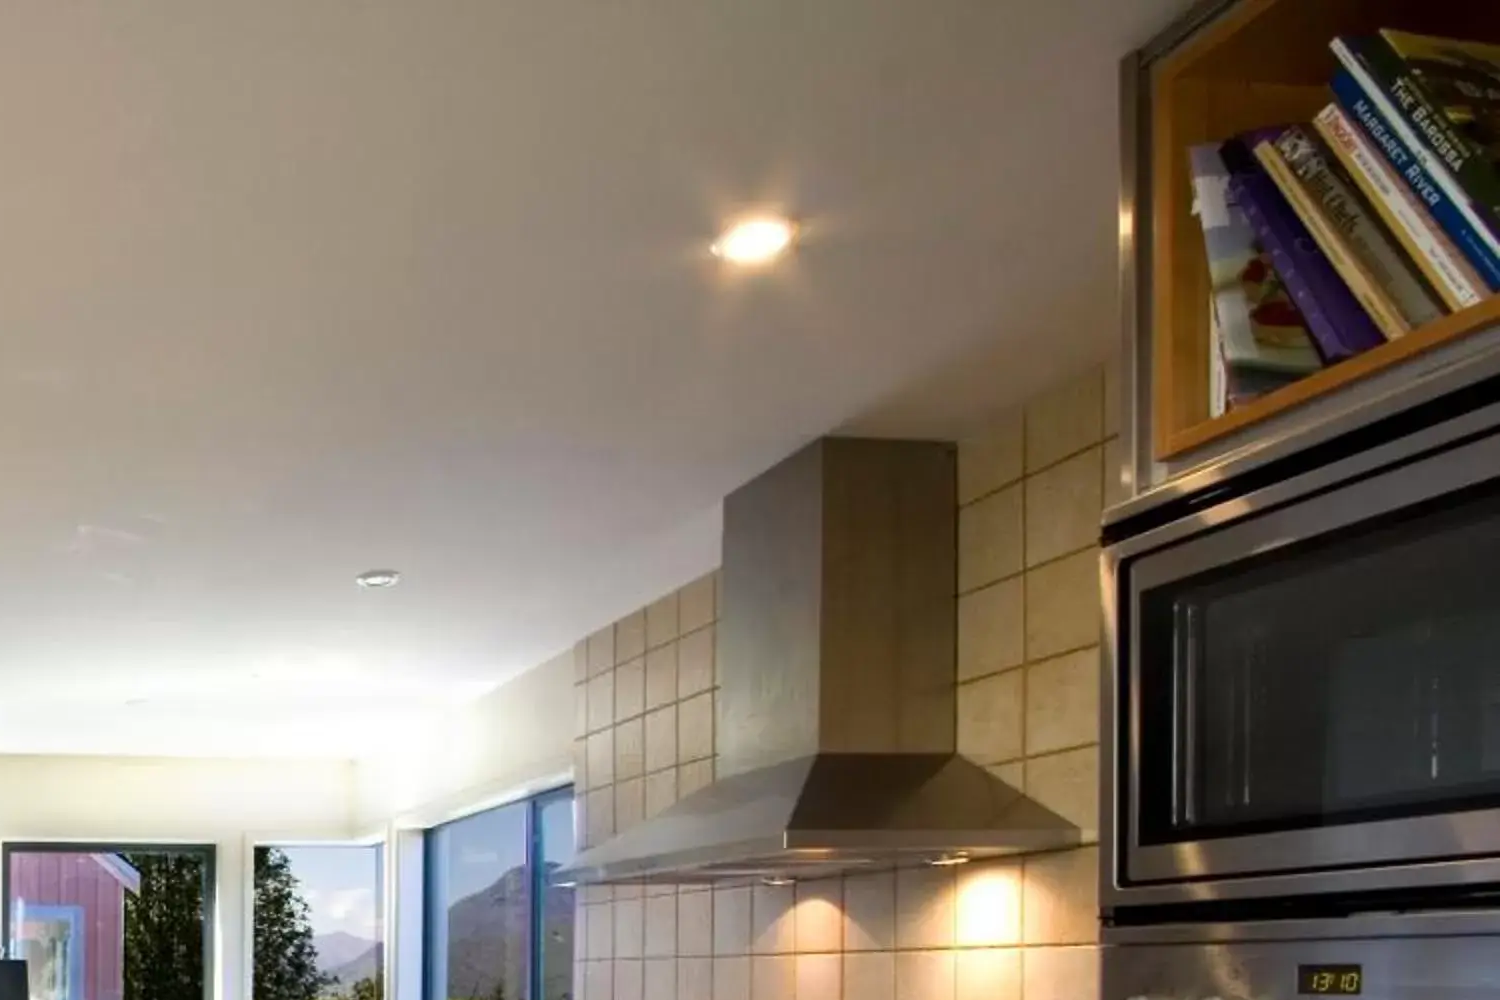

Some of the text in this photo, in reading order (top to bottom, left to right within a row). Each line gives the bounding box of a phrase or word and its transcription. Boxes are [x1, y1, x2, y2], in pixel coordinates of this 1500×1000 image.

[1352, 98, 1409, 166] MARGARET
[1404, 164, 1441, 207] RIVER
[1389, 77, 1417, 110] THE
[1412, 107, 1465, 173] BAROSSA
